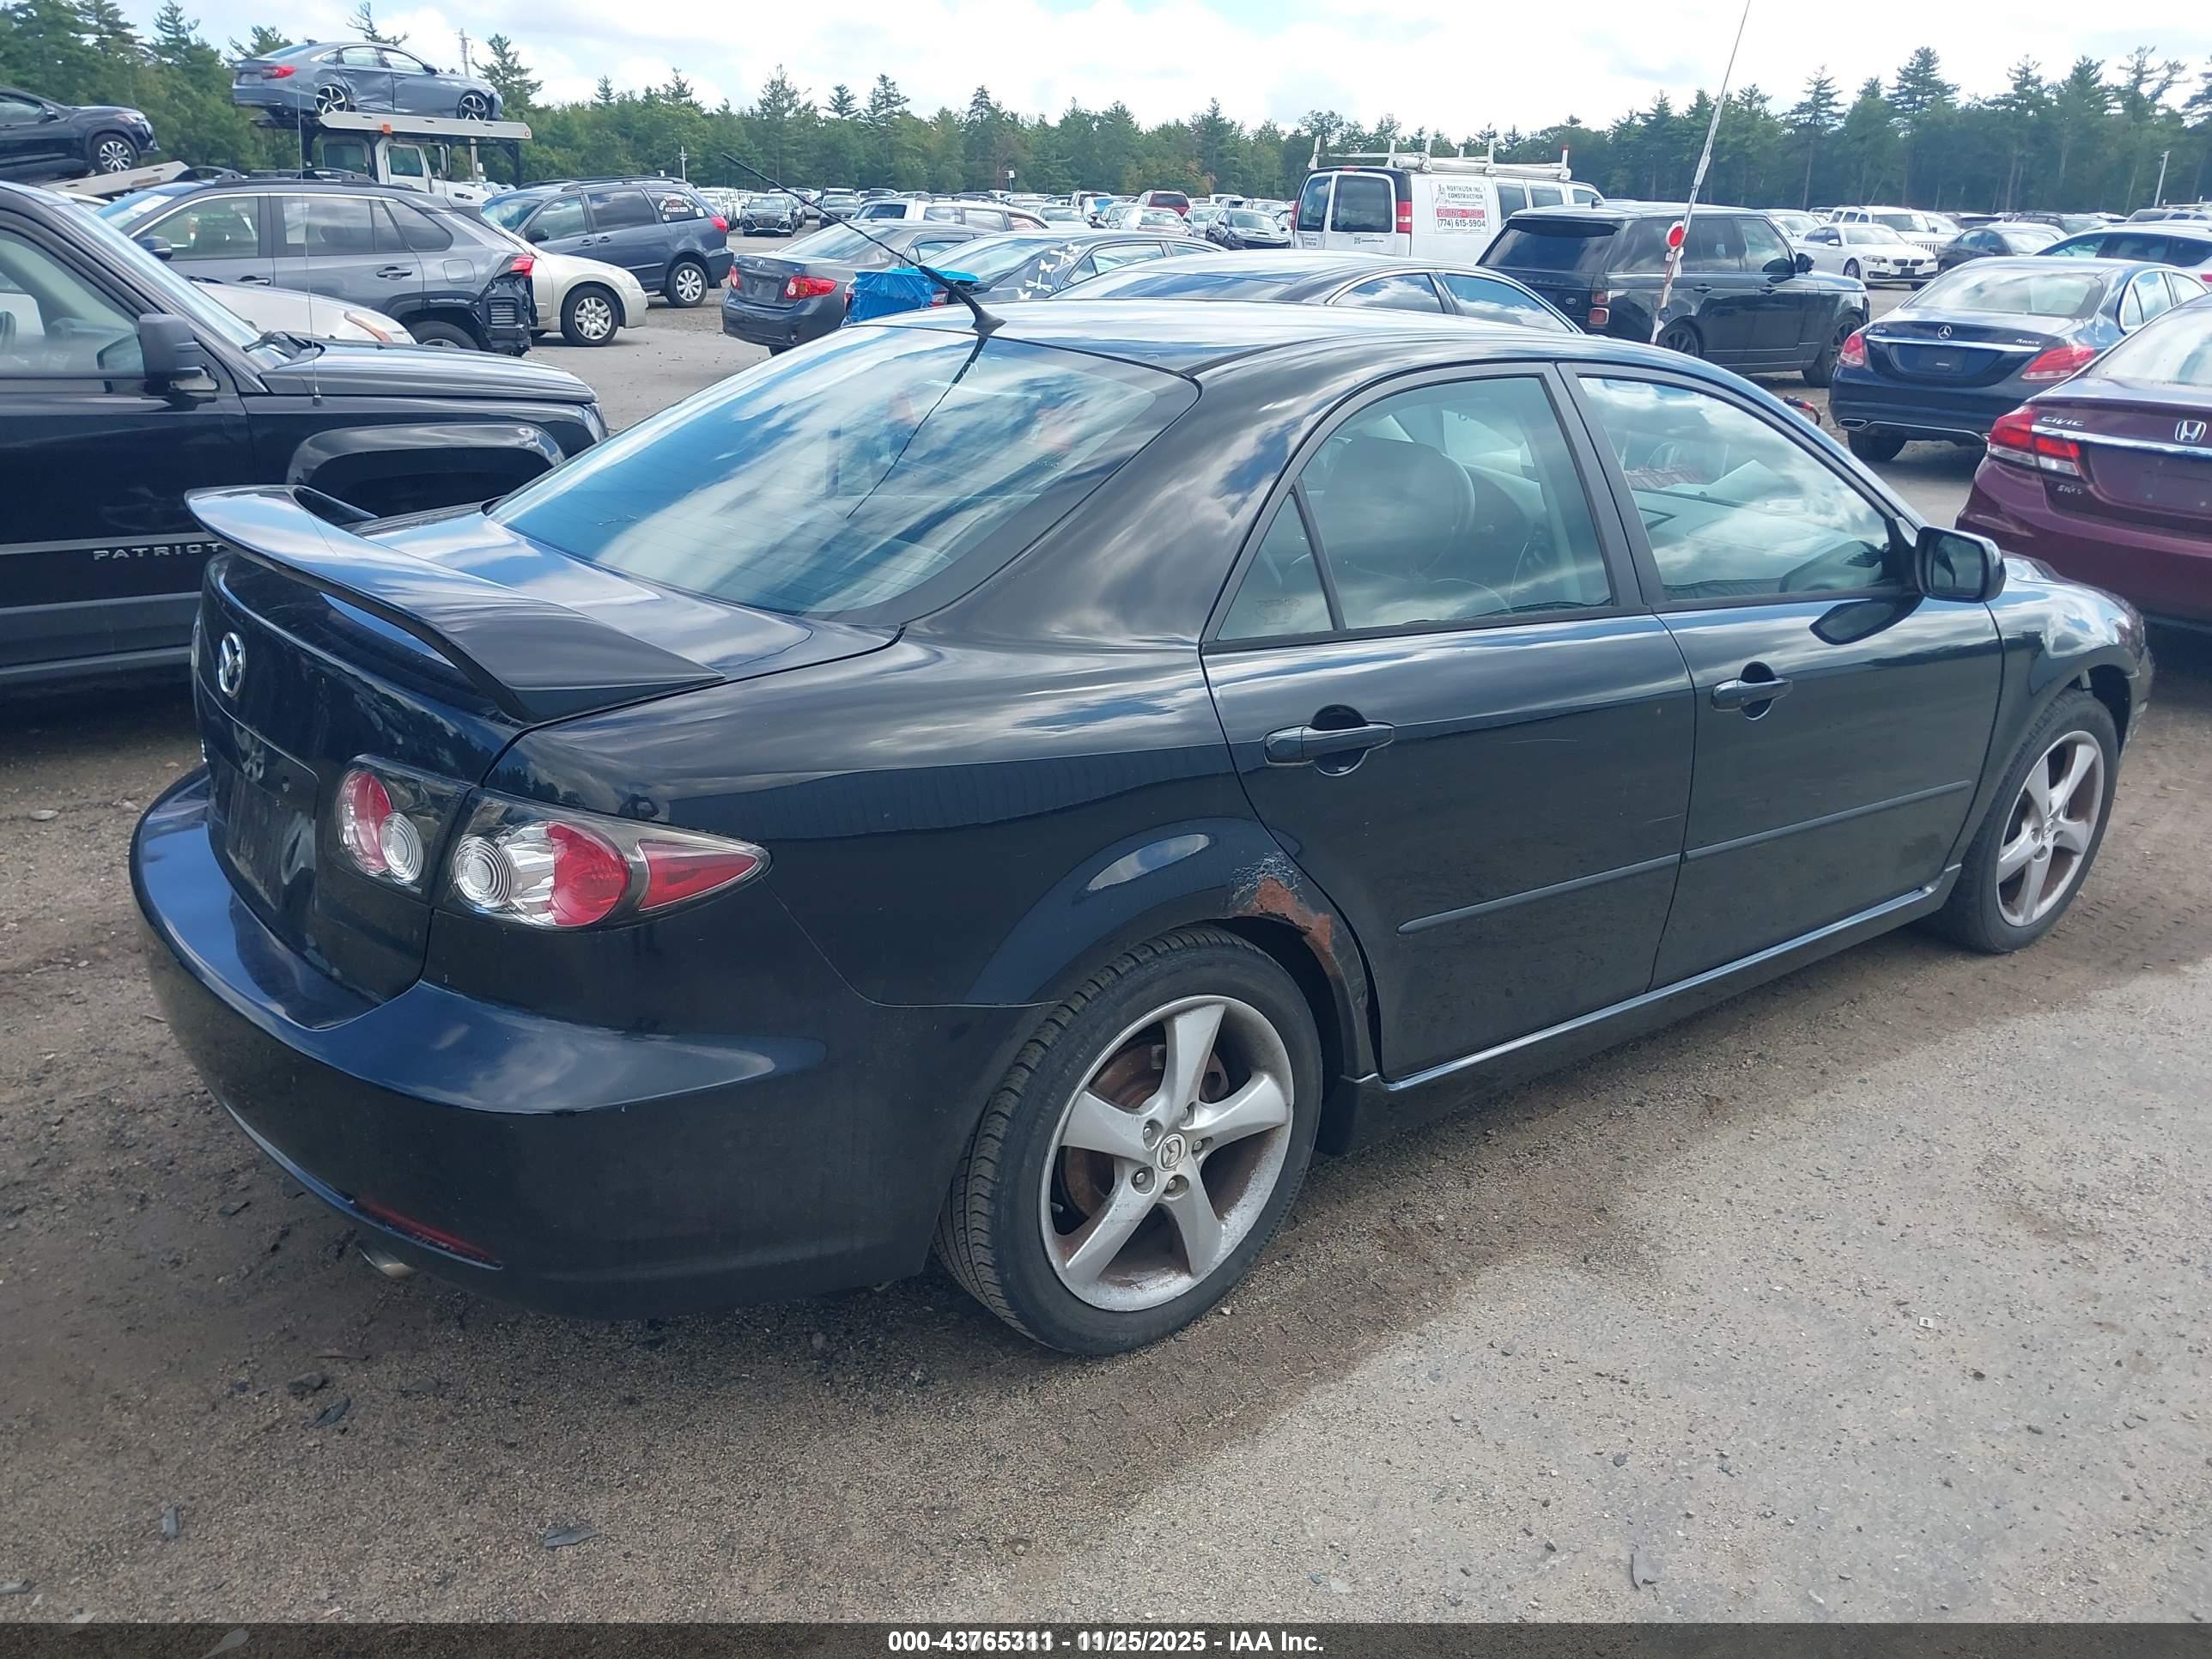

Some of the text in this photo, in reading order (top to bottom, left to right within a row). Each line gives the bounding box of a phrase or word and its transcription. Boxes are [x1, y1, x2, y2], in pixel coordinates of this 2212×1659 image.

[1437, 218, 1486, 228] (774) 615-5904
[2040, 416, 2085, 427] CIVIC
[92, 542, 222, 561] PATRIOT
